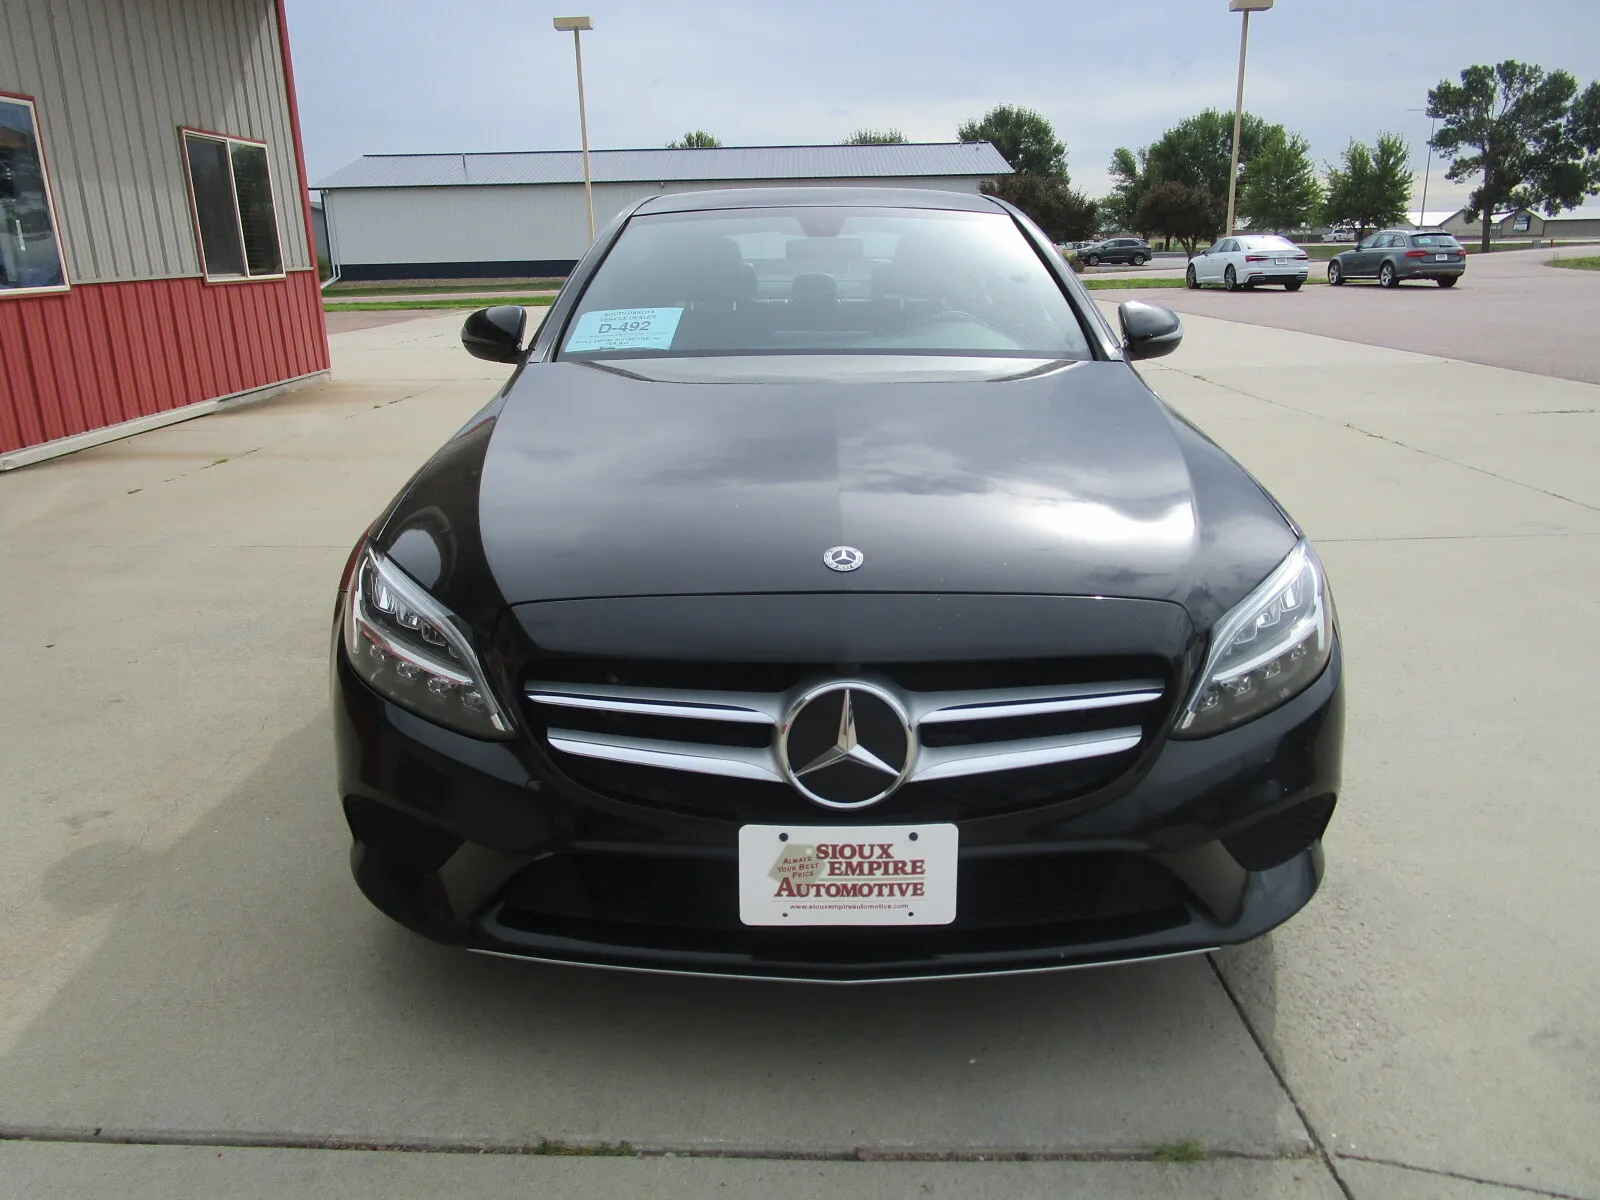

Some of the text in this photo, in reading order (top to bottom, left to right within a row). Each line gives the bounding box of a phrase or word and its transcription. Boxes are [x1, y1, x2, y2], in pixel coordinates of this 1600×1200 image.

[598, 321, 651, 334] D-492
[816, 844, 894, 860] SIOUX
[783, 856, 812, 865] ALWAYS
[777, 863, 819, 873] YOUR BEST
[827, 859, 925, 876] EMPIRE
[774, 877, 925, 897] AUTOMOTIVE
[790, 903, 909, 911] www.siouxempireautomotive.com
